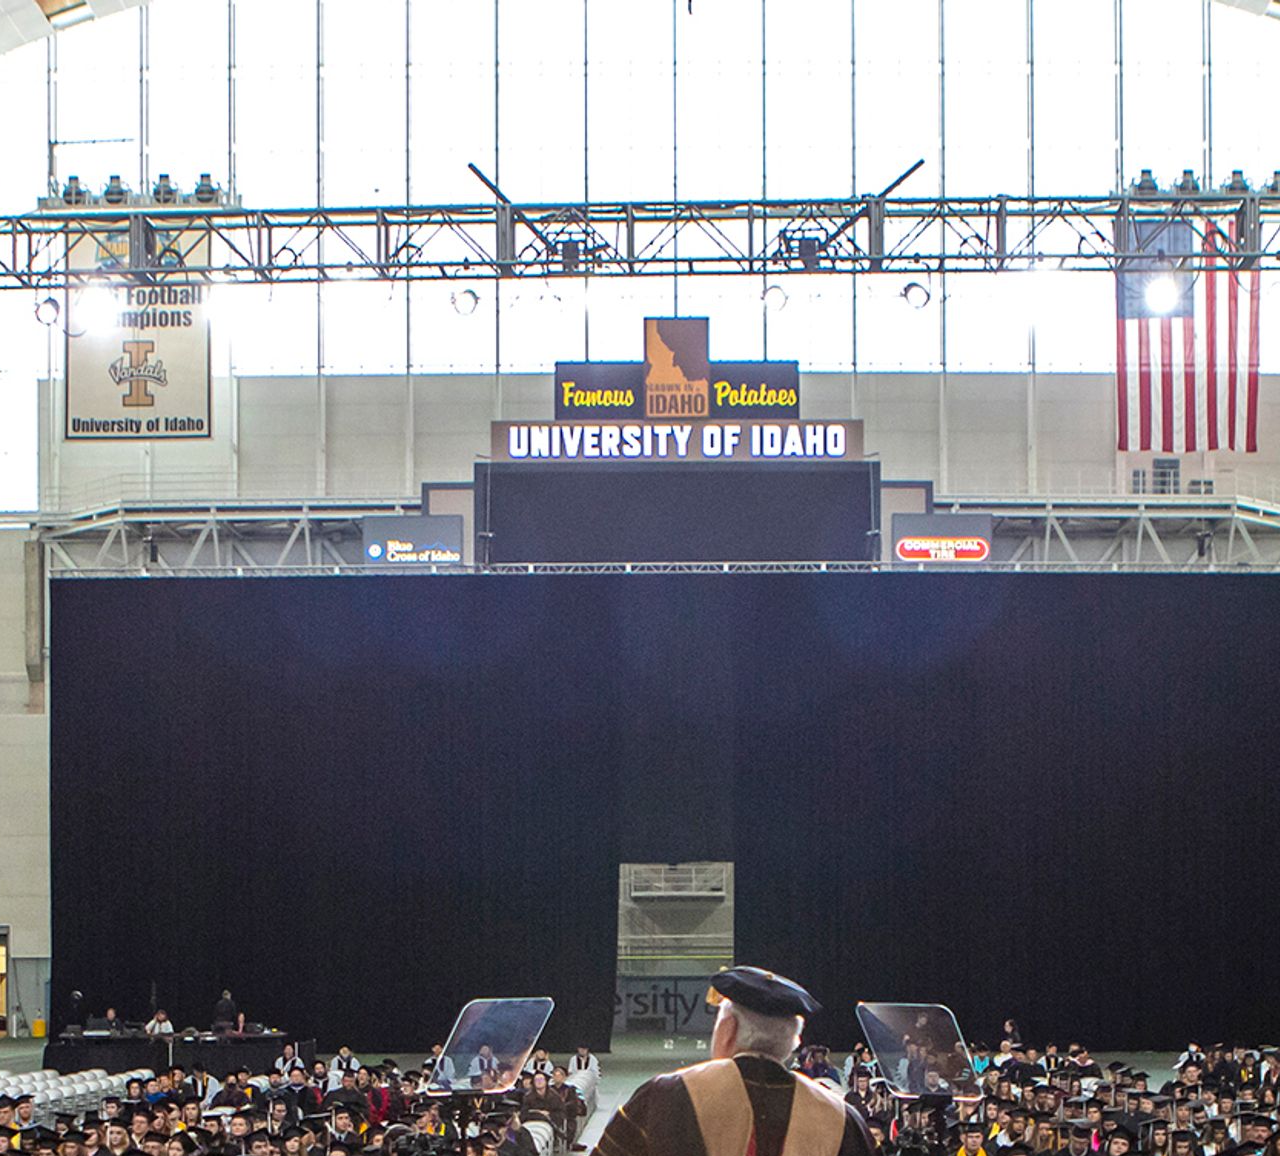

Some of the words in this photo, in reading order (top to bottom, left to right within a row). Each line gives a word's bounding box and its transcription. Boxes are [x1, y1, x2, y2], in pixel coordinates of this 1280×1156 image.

[127, 285, 201, 305] Football
[120, 309, 193, 330] mpions
[108, 356, 168, 386] Vandals
[562, 381, 635, 407] Famous
[714, 381, 797, 407] Potatoes
[649, 394, 705, 415] IDAHO
[72, 417, 142, 434] University
[146, 417, 160, 433] of
[164, 417, 204, 433] Idaho
[508, 424, 692, 458] UNIVERSITY
[702, 424, 742, 458] OF
[751, 424, 846, 458] IDAHO
[904, 540, 980, 551] COMMERCIAL
